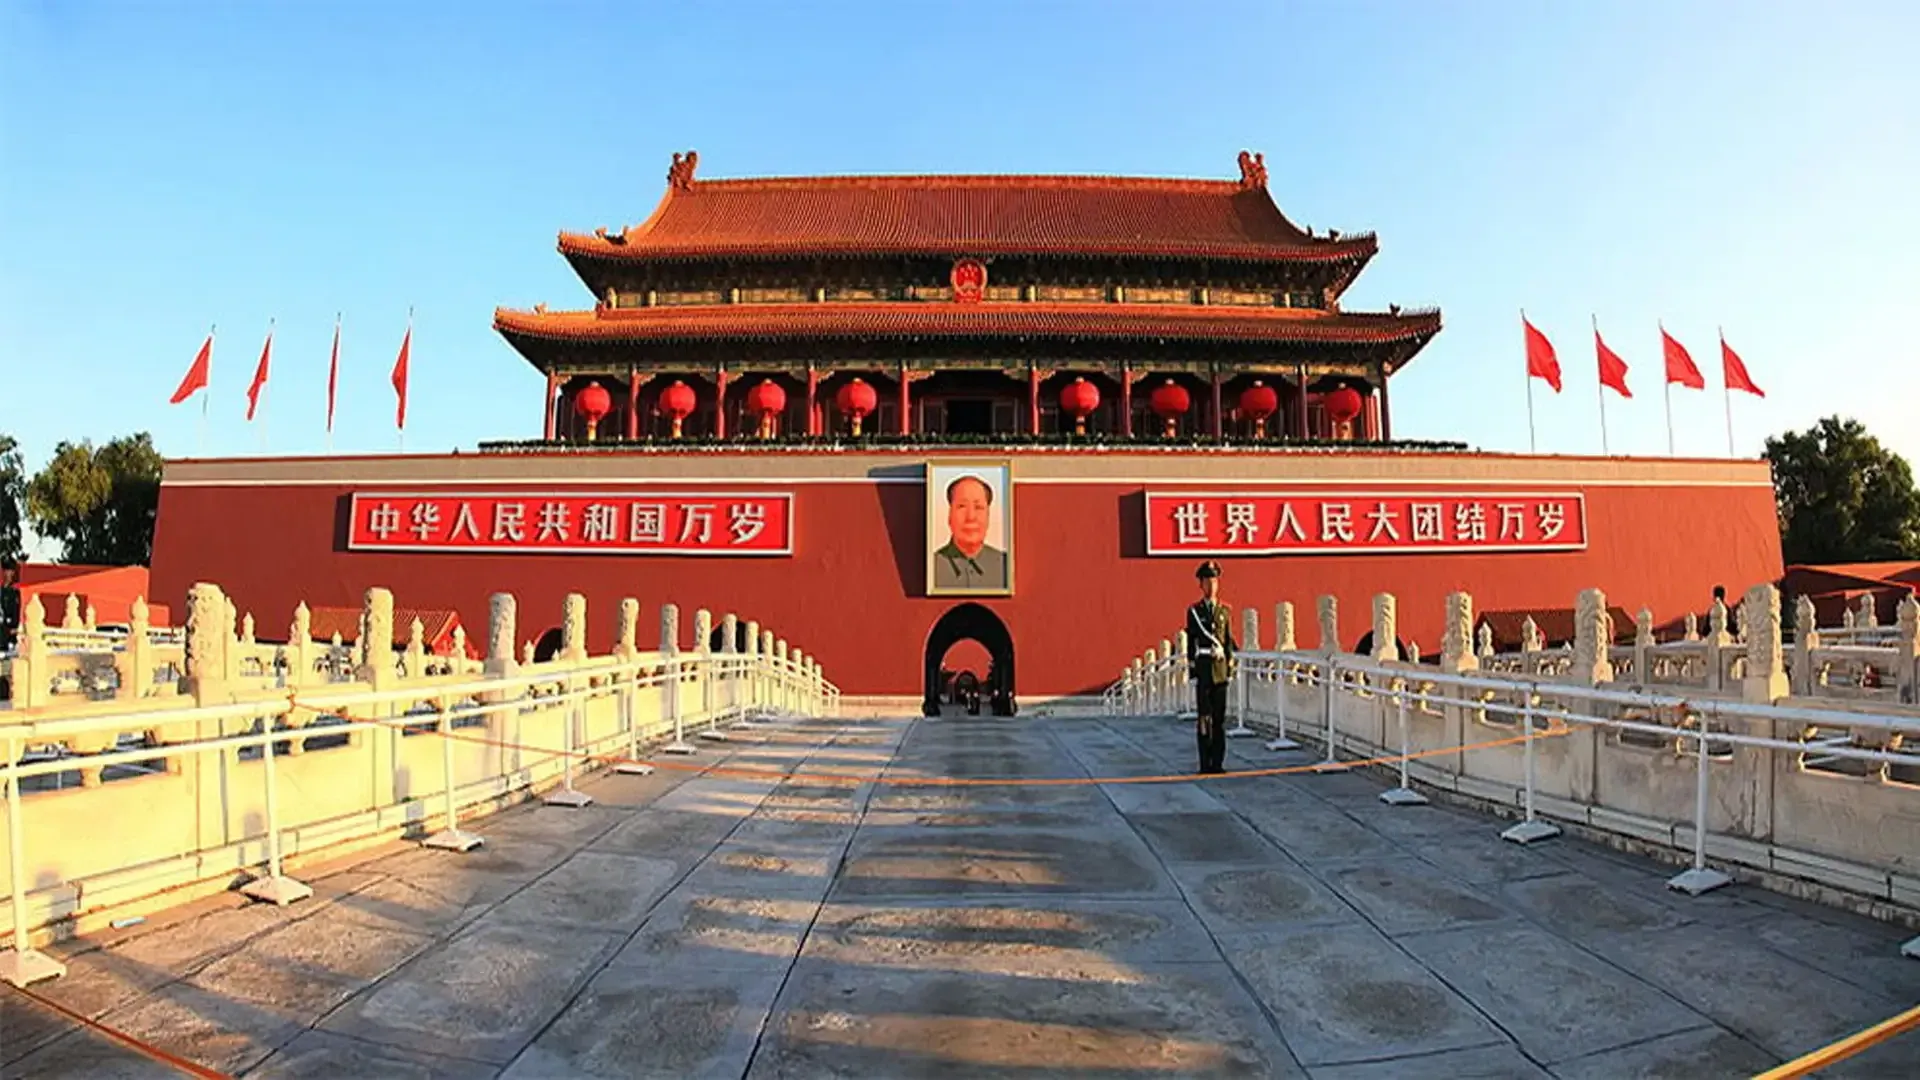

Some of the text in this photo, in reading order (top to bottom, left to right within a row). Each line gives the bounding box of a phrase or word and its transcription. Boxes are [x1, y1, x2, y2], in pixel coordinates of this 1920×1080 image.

[370, 502, 766, 545] 中华人民共和国万岁
[1173, 502, 1566, 544] 世界人民大团结万岁
